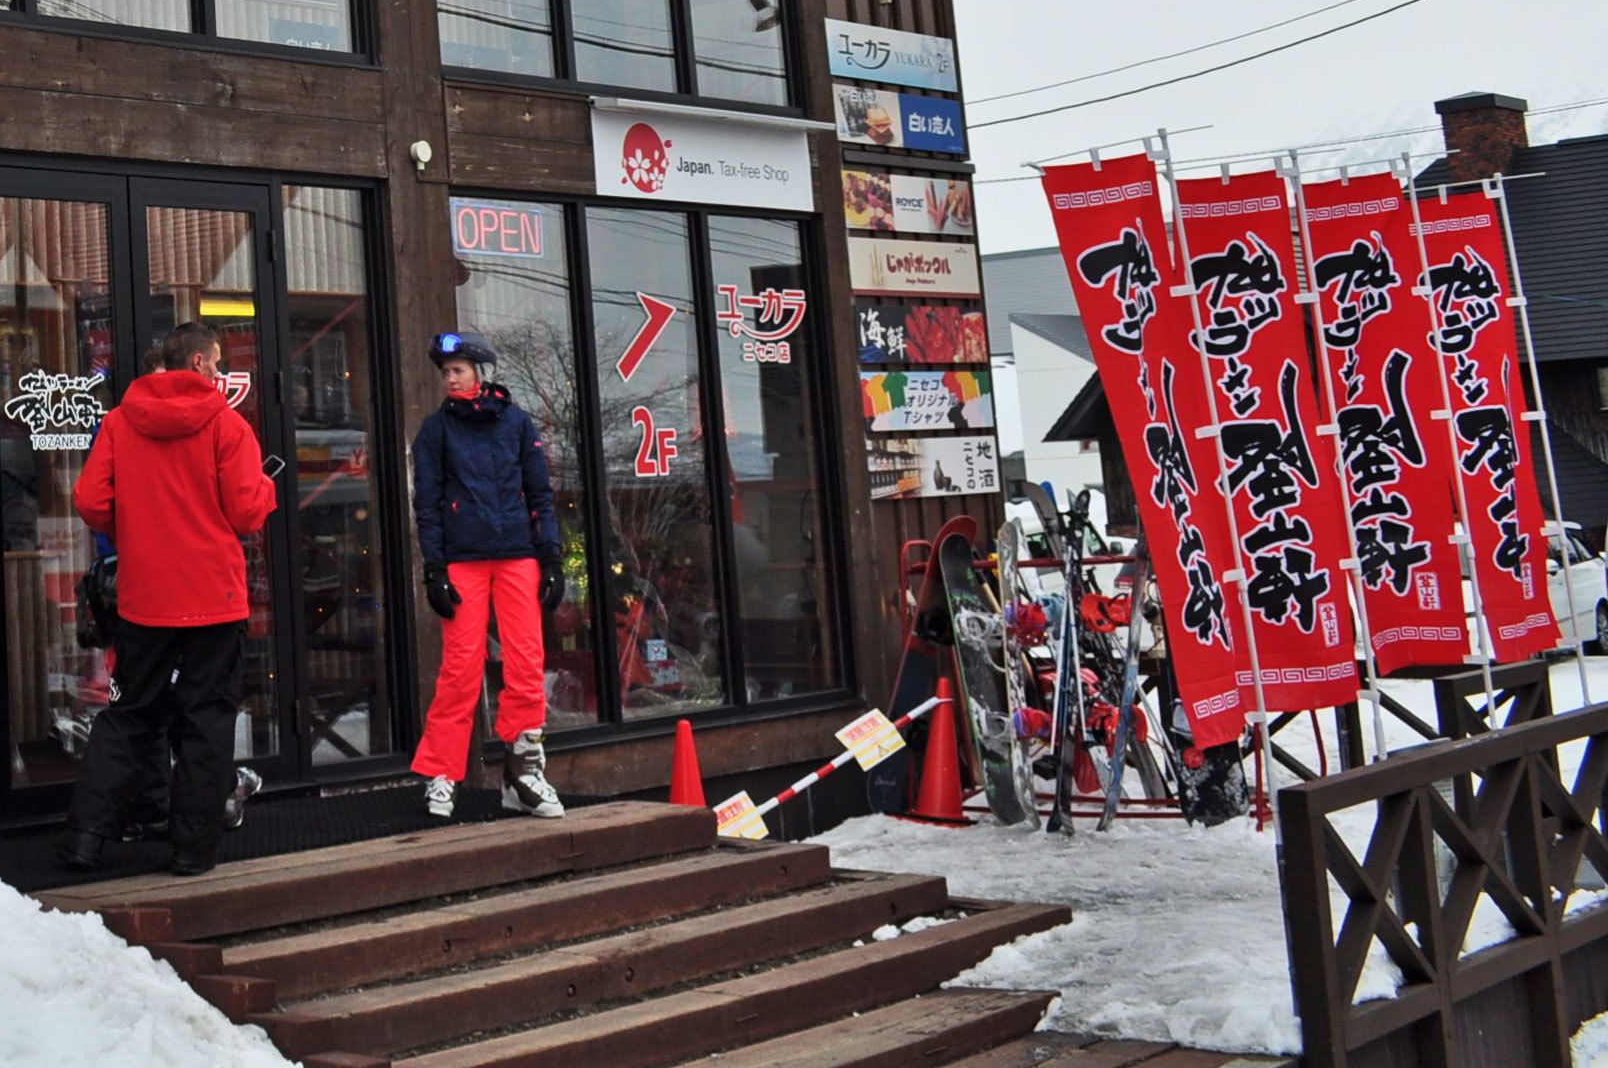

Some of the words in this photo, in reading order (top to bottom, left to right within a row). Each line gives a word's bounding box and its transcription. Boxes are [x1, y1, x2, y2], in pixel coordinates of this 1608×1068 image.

[838, 33, 891, 70] ユーカラ
[894, 51, 932, 68] YUKARA
[936, 53, 950, 73] 2F
[909, 113, 955, 137] 白い恋人
[718, 158, 761, 181] Tax-free
[763, 164, 790, 184] Shop
[457, 207, 541, 254] OPEN
[716, 284, 806, 340] ユーカラ
[859, 308, 907, 359] 海鮮
[743, 342, 791, 364] ニセコ店
[905, 393, 958, 408] オリジナル
[908, 379, 940, 392] ニセコ
[903, 411, 944, 425] Tシャツ
[30, 434, 92, 450] TOZANKEN
[632, 405, 678, 477] 2F
[963, 441, 976, 489] ニセコの
[977, 441, 995, 488] 地酒
